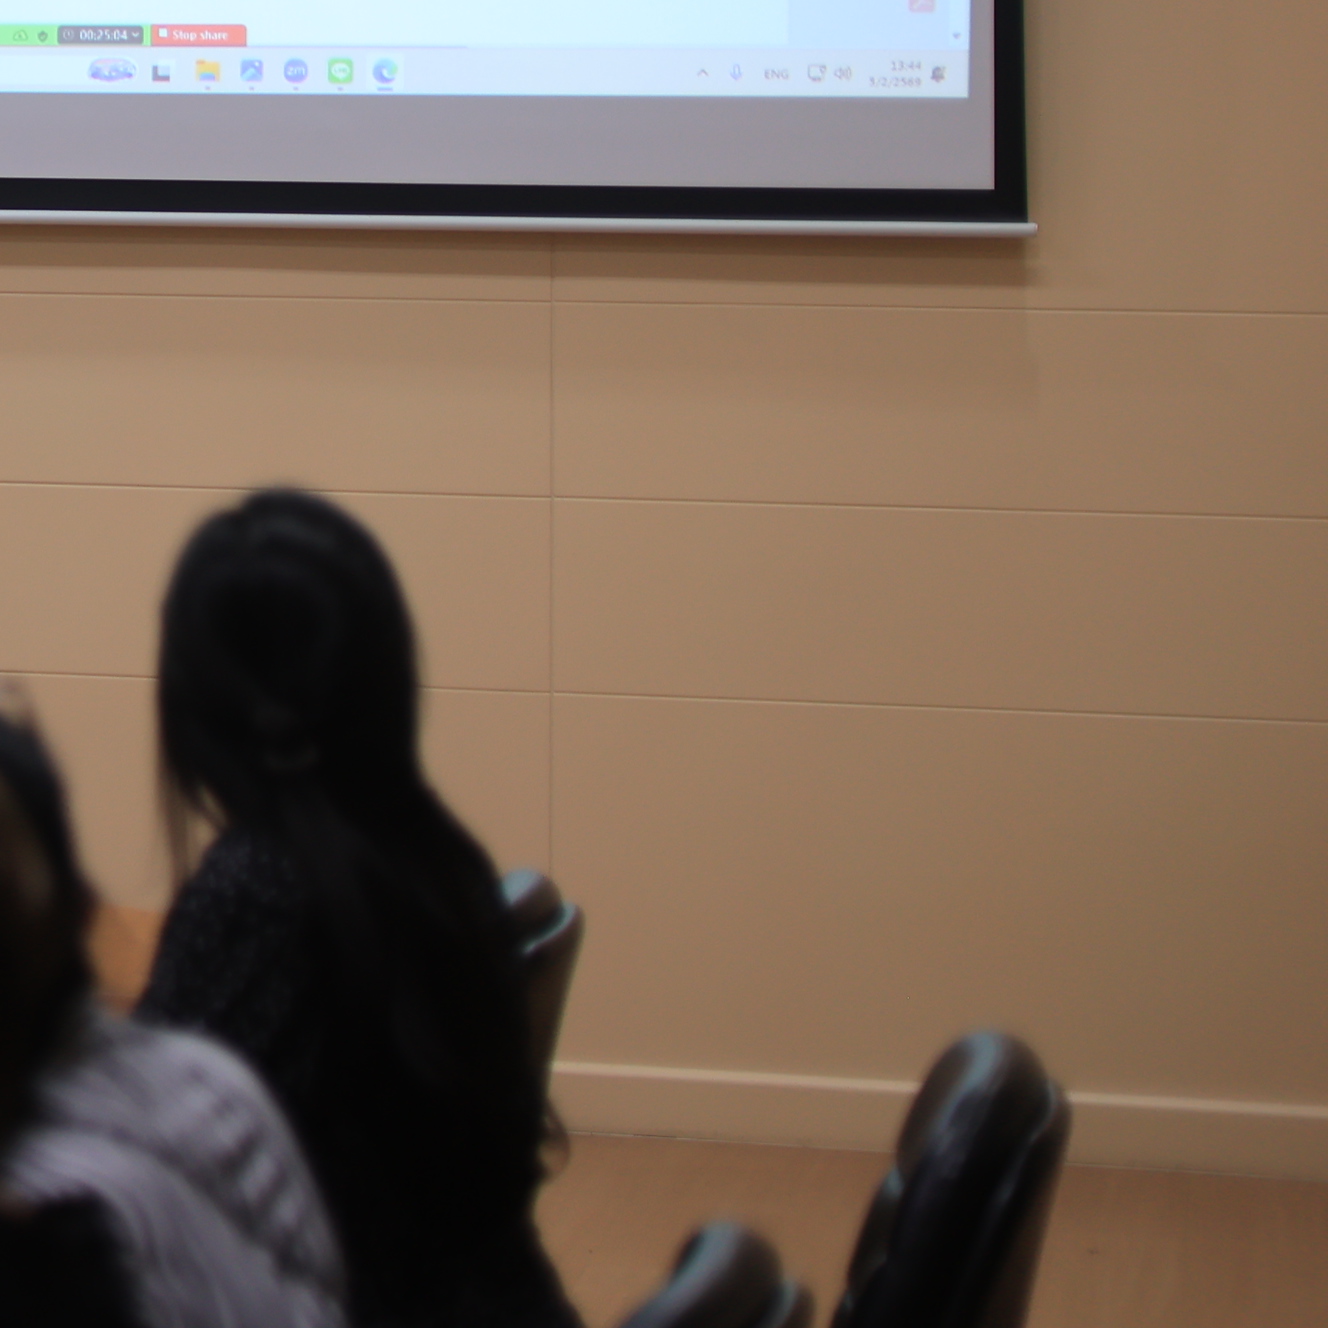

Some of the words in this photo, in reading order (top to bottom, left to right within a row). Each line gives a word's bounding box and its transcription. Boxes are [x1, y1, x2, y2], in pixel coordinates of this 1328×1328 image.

[80, 28, 128, 41] 00:25:04
[173, 29, 197, 41] Stop
[200, 29, 228, 40] share
[763, 68, 790, 80] ENG
